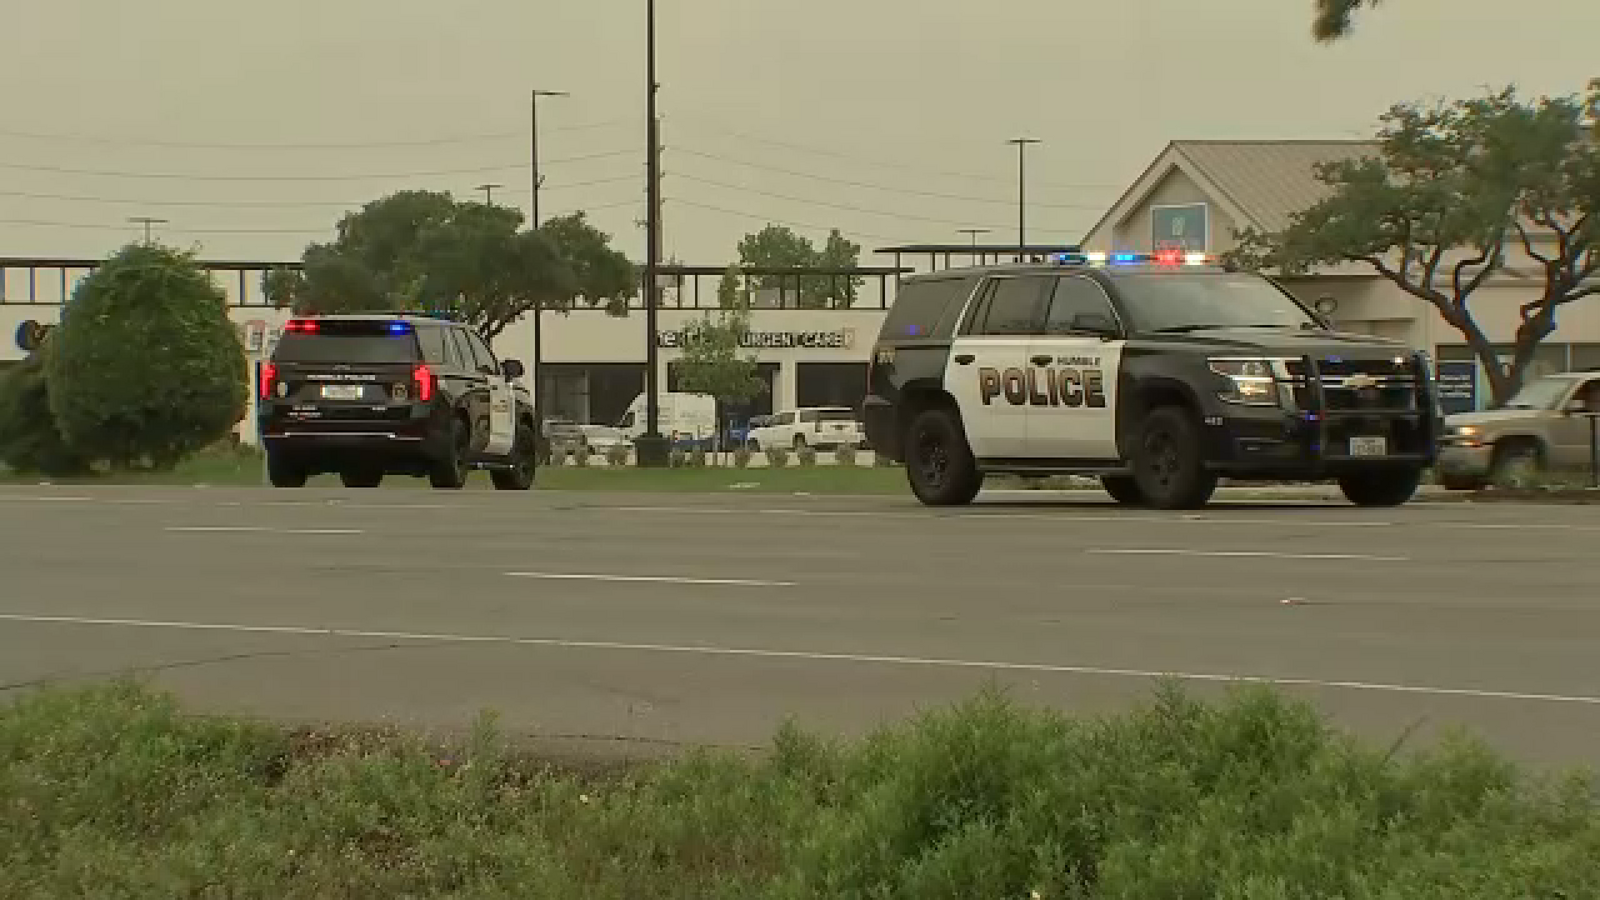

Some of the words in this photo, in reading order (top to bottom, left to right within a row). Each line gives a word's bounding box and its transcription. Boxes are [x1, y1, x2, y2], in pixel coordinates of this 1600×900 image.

[739, 331, 797, 348] URGENT
[799, 331, 843, 348] CARE
[979, 367, 1106, 408] POLICE
